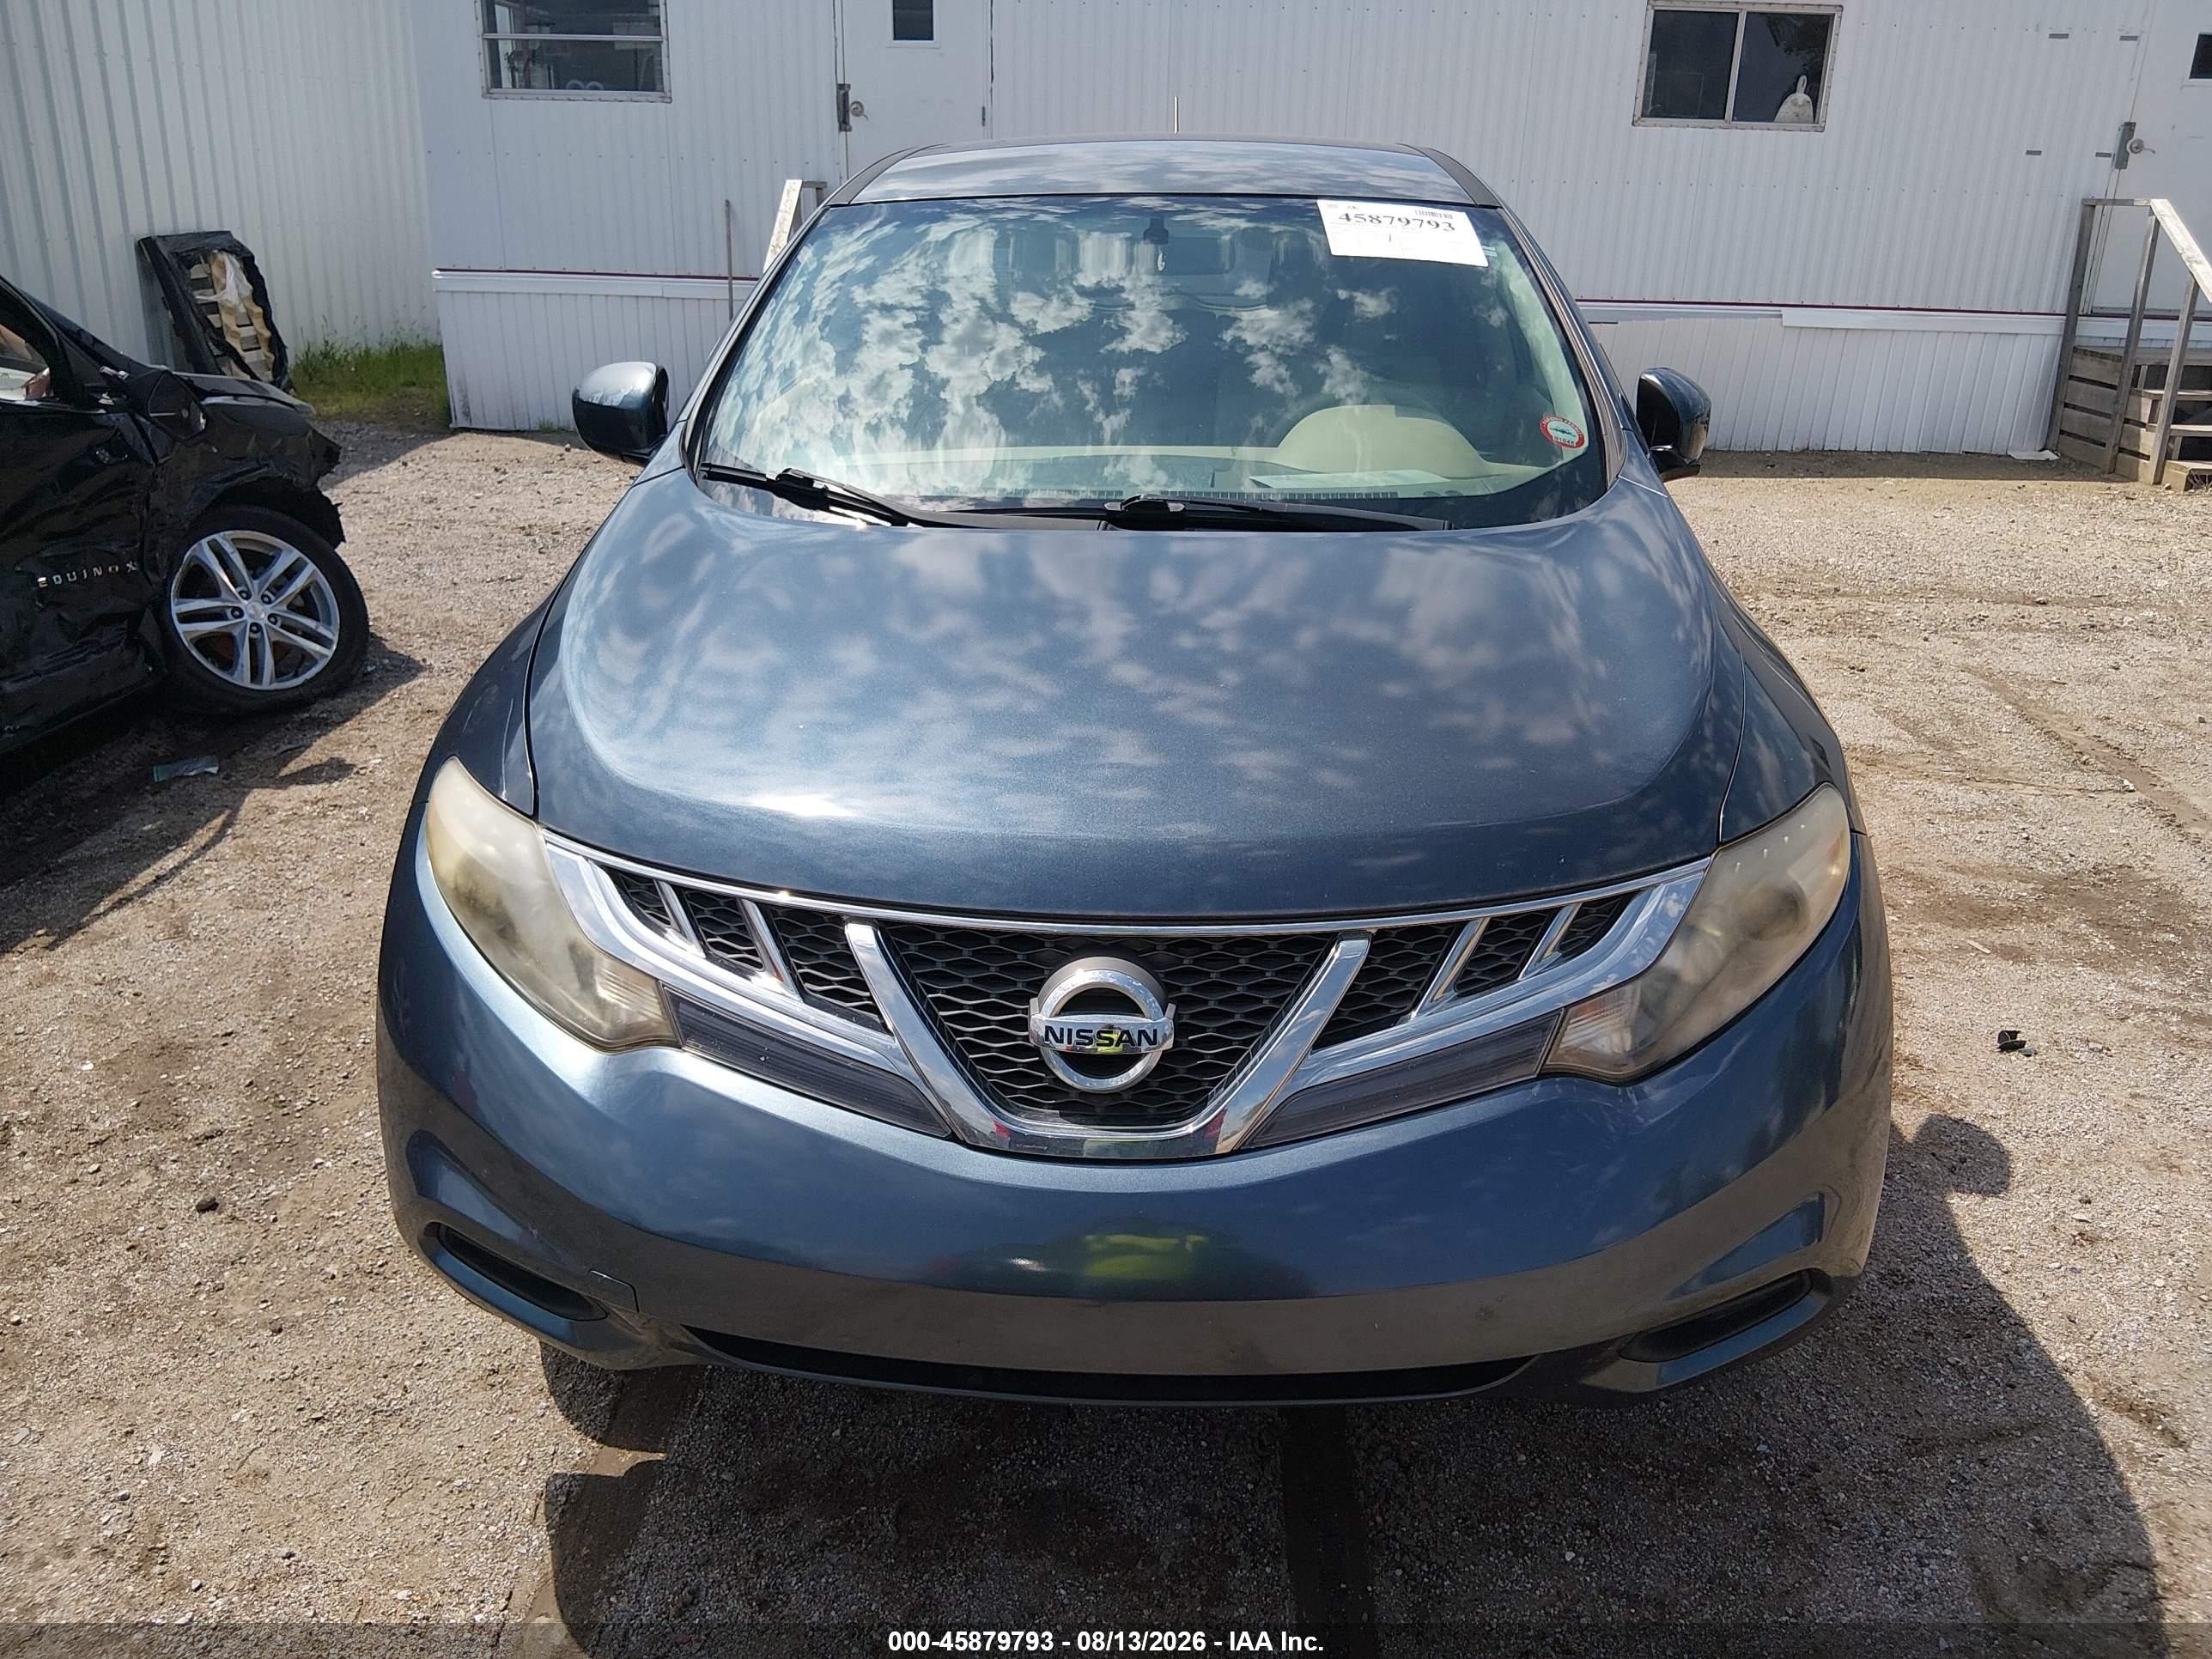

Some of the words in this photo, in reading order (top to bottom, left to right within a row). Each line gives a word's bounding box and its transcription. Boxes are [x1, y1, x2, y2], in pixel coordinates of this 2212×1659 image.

[1339, 212, 1455, 232] 45879793
[37, 560, 138, 588] EQUINOX
[1044, 1025, 1158, 1048] NISSAN
